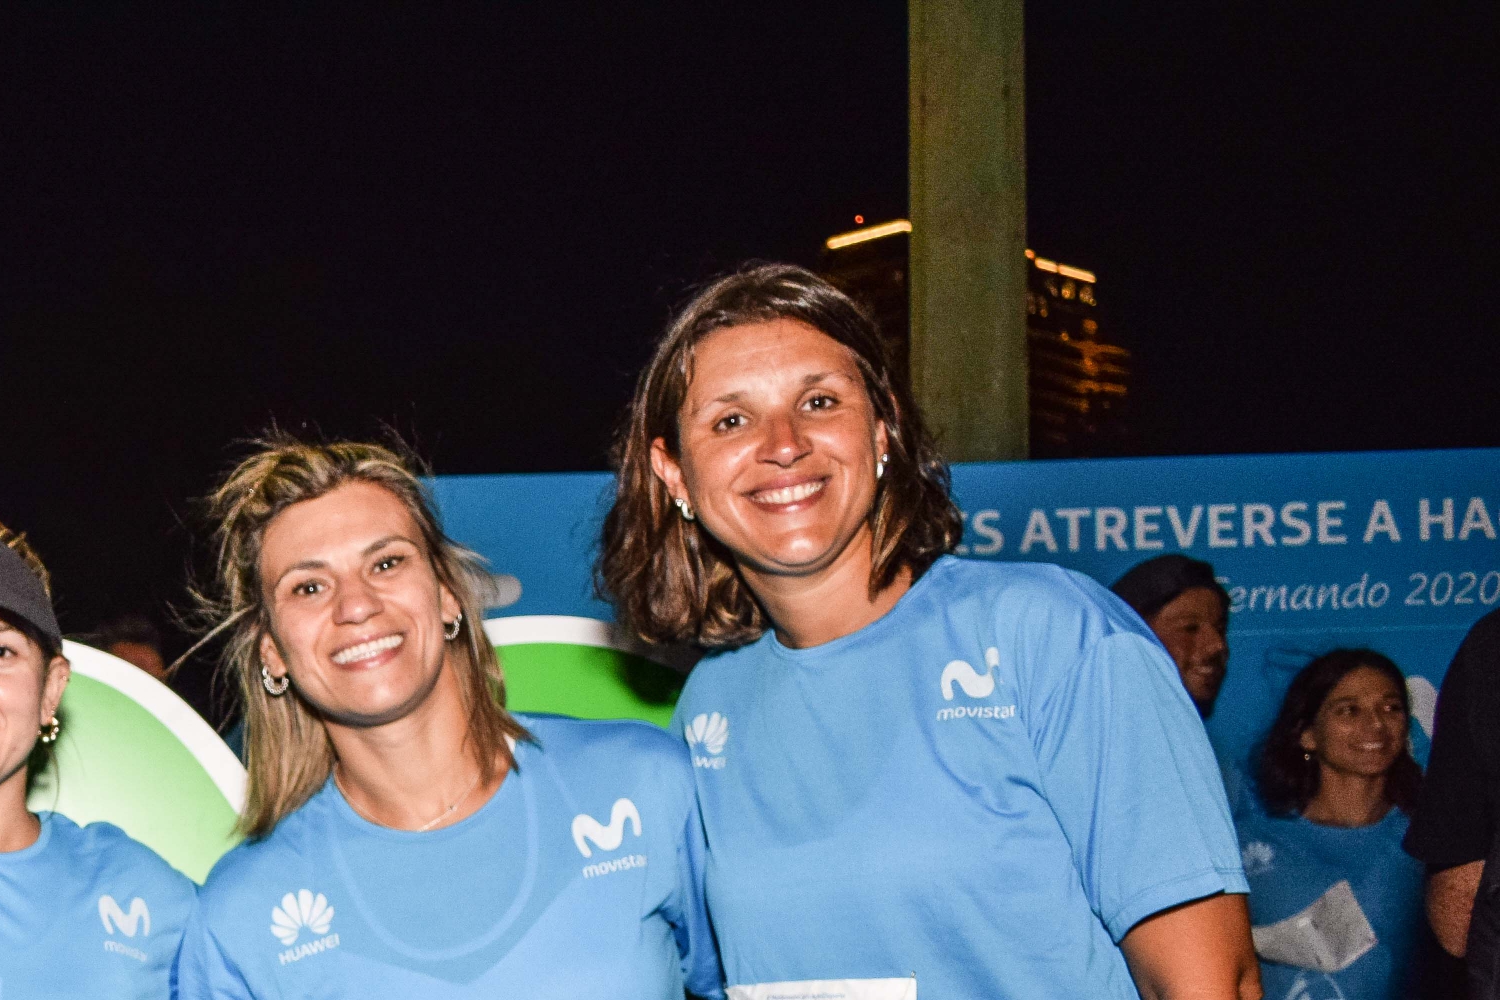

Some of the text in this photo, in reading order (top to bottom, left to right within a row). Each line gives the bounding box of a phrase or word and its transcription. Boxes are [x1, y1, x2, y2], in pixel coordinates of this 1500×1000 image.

[1019, 501, 1348, 554] ATREVERSE
[1362, 499, 1401, 543] A
[1404, 571, 1500, 607] 2020
[936, 703, 1016, 722] movistar
[581, 854, 648, 879] movista
[277, 933, 341, 966] HUAWEI
